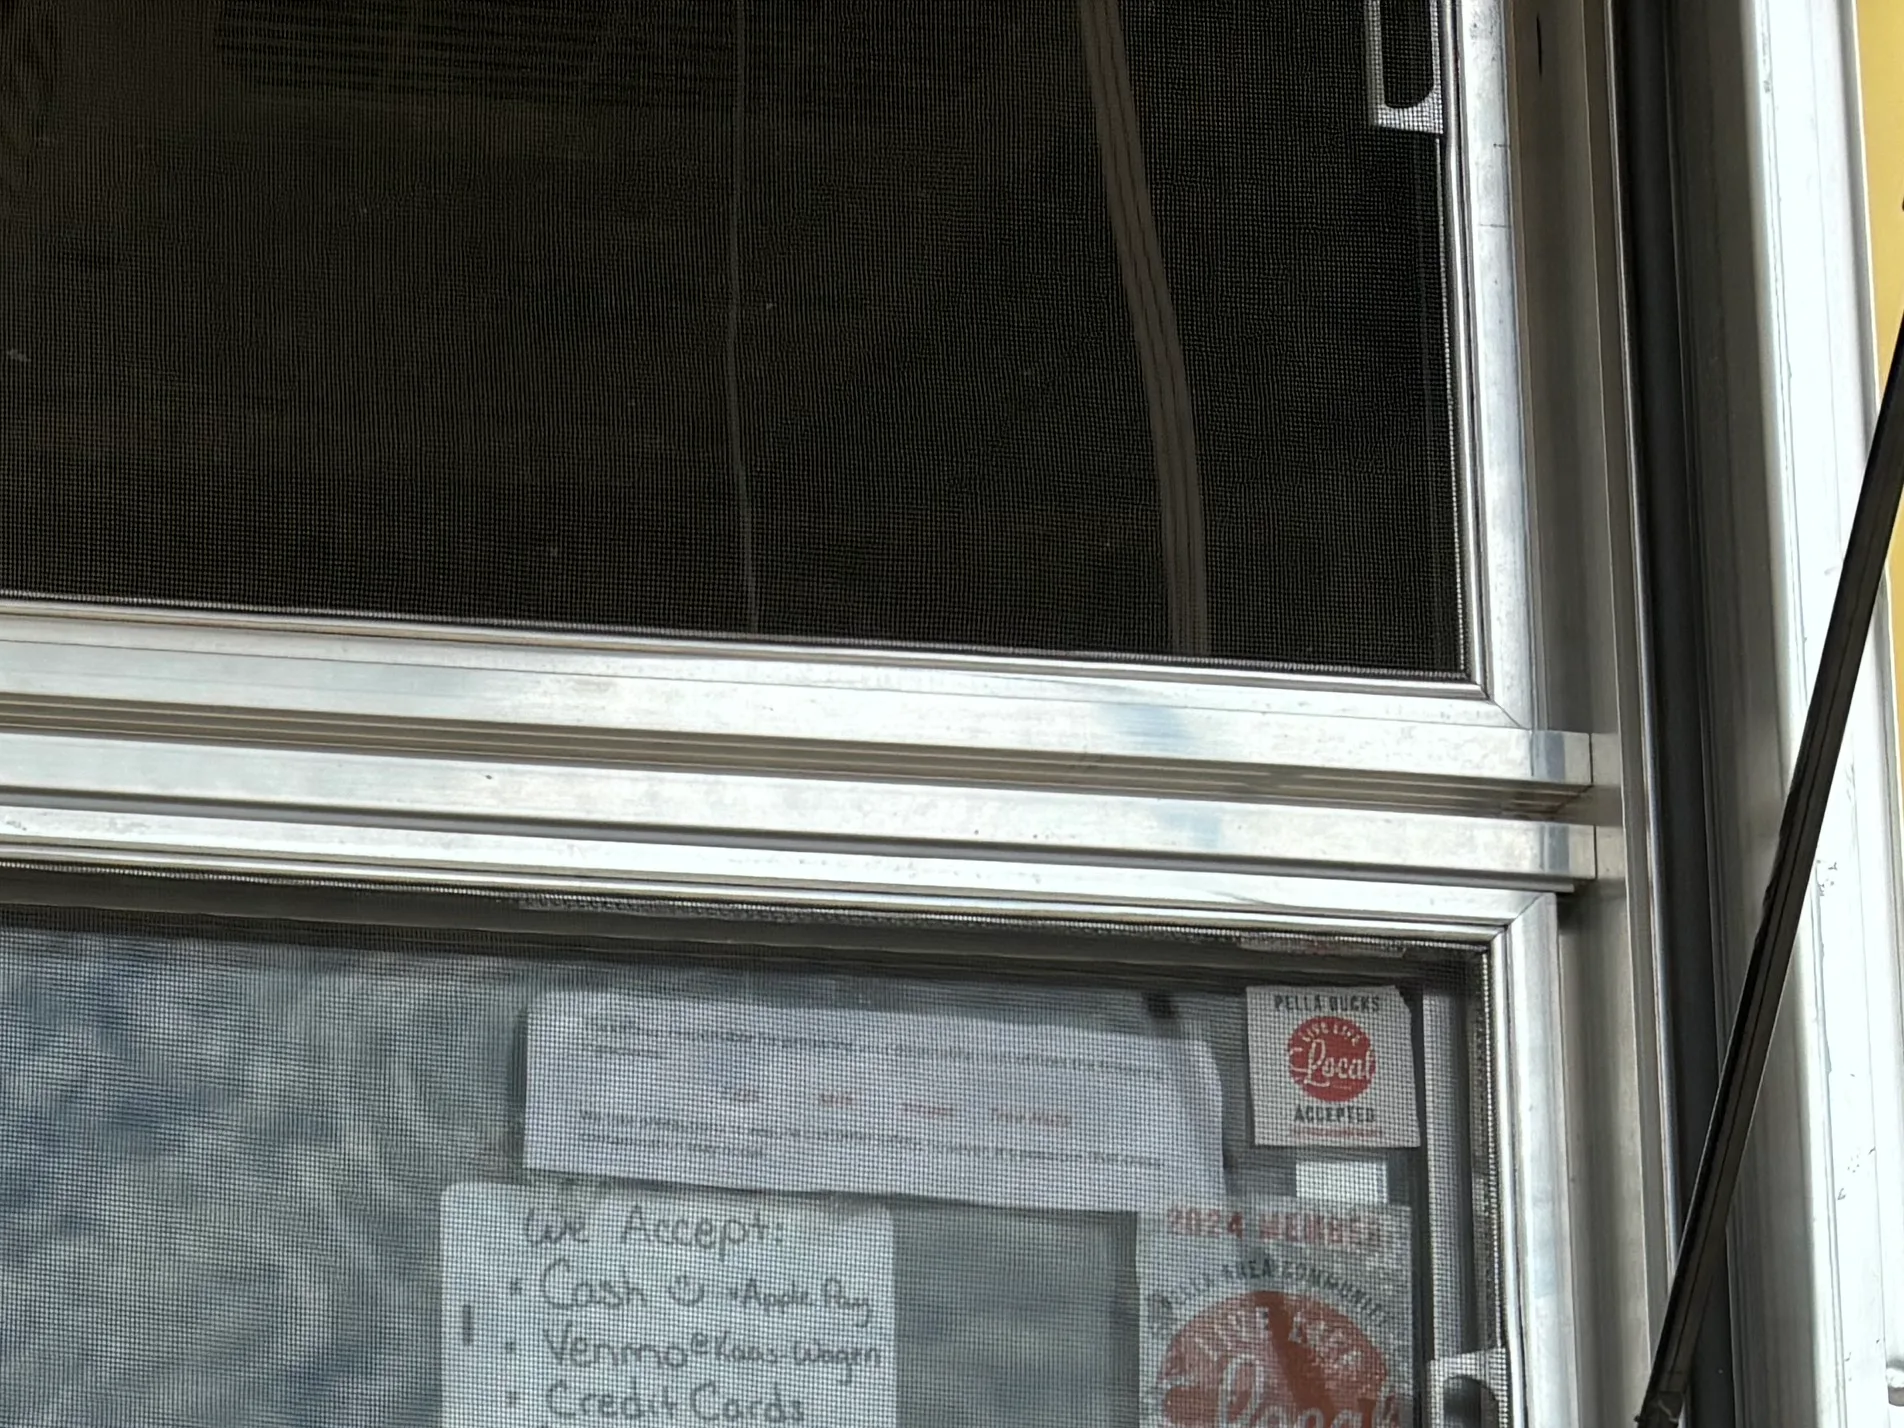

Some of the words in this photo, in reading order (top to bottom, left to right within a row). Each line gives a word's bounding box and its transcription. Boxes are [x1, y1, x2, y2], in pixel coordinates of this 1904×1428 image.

[1274, 994, 1322, 1012] PELLA
[1328, 995, 1382, 1013] BUCKS
[1288, 1037, 1375, 1087] Local
[1294, 1106, 1376, 1124] ACCEPTED
[621, 1203, 785, 1262] Accept:
[1167, 1206, 1245, 1240] 2024
[1258, 1211, 1383, 1252] MEMBER
[540, 1257, 648, 1310] Cash
[739, 1276, 815, 1317] Apple
[821, 1276, 874, 1328] Pay
[543, 1319, 689, 1370] Venmo
[545, 1376, 679, 1421] Credit
[690, 1380, 806, 1425] Cards
